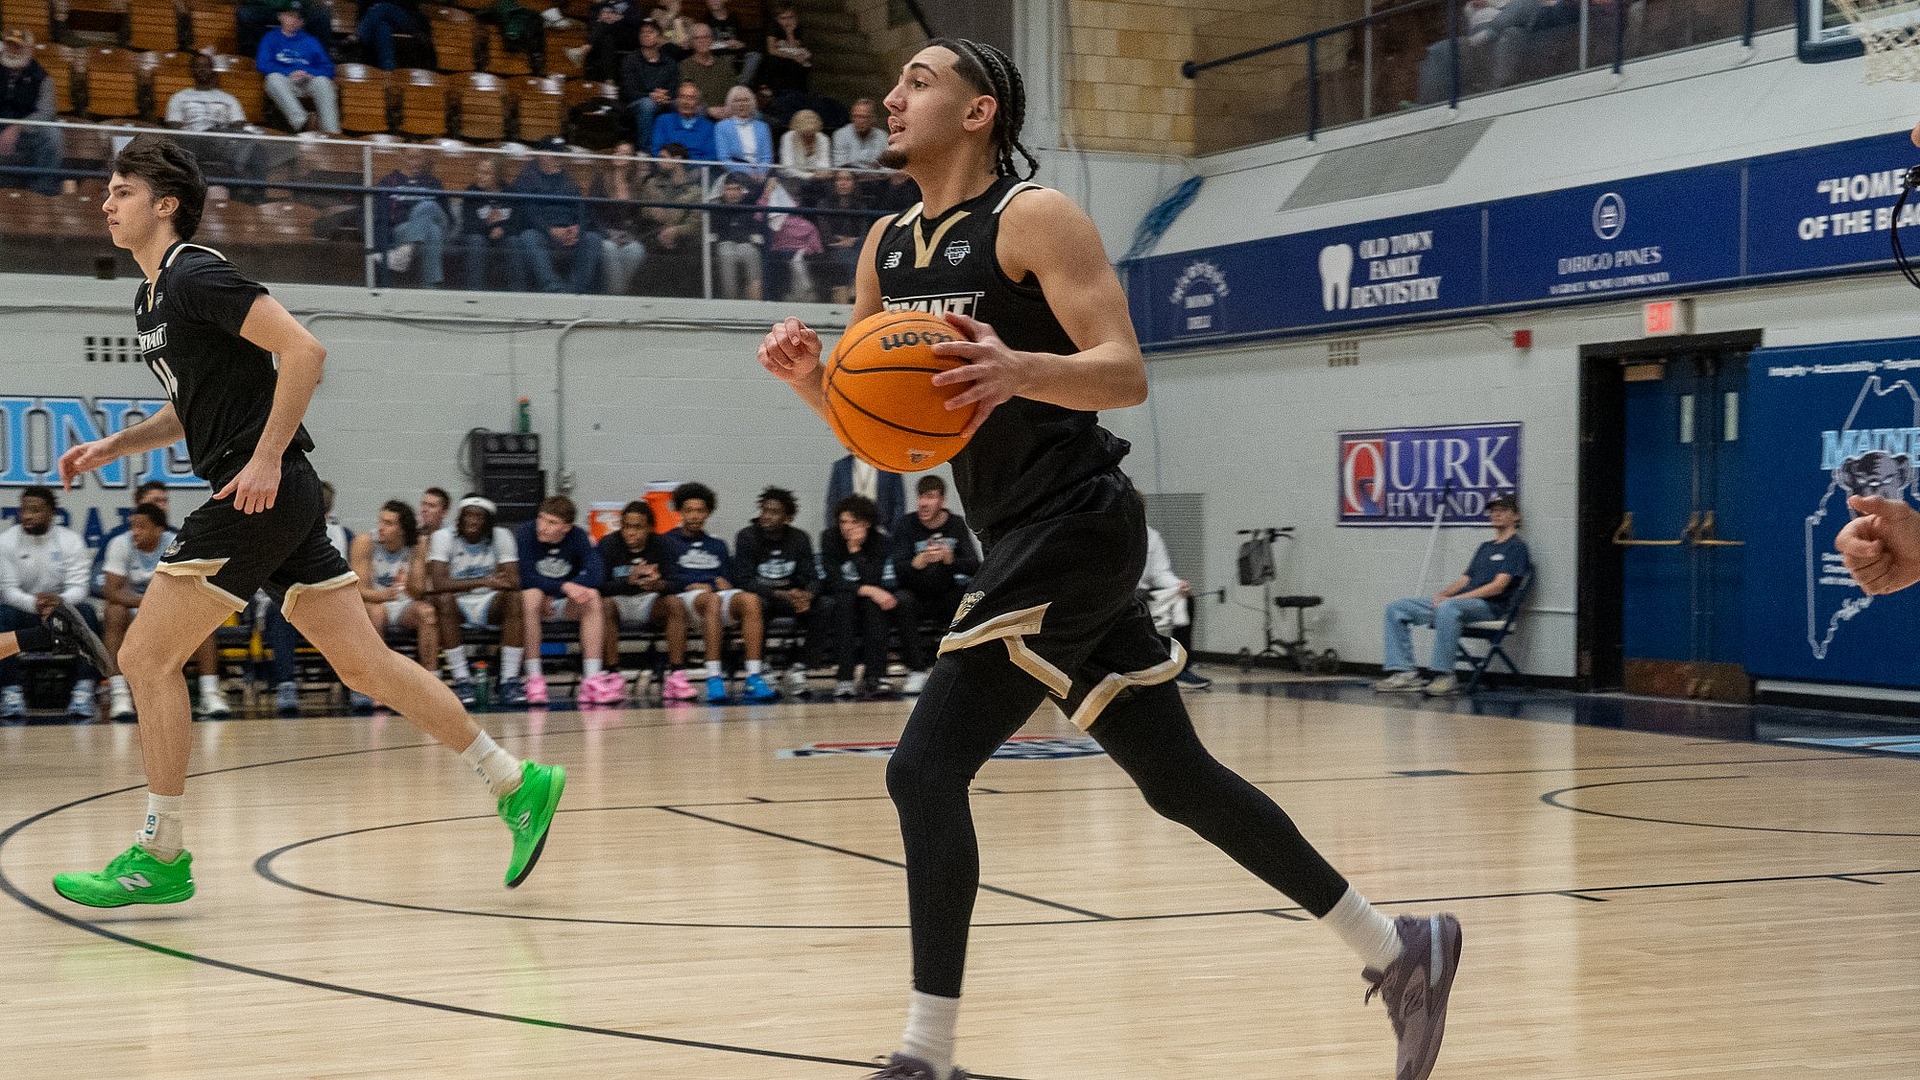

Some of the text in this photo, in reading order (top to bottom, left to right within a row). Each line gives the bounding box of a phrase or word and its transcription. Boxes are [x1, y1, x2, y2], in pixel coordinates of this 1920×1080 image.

[1798, 216, 1828, 240] OF
[1830, 209, 1872, 236] THE
[1369, 255, 1422, 280] FAMILY
[1614, 246, 1662, 268] PINES
[1350, 276, 1442, 309] DENTISTRY
[1344, 436, 1515, 514] QUIRK
